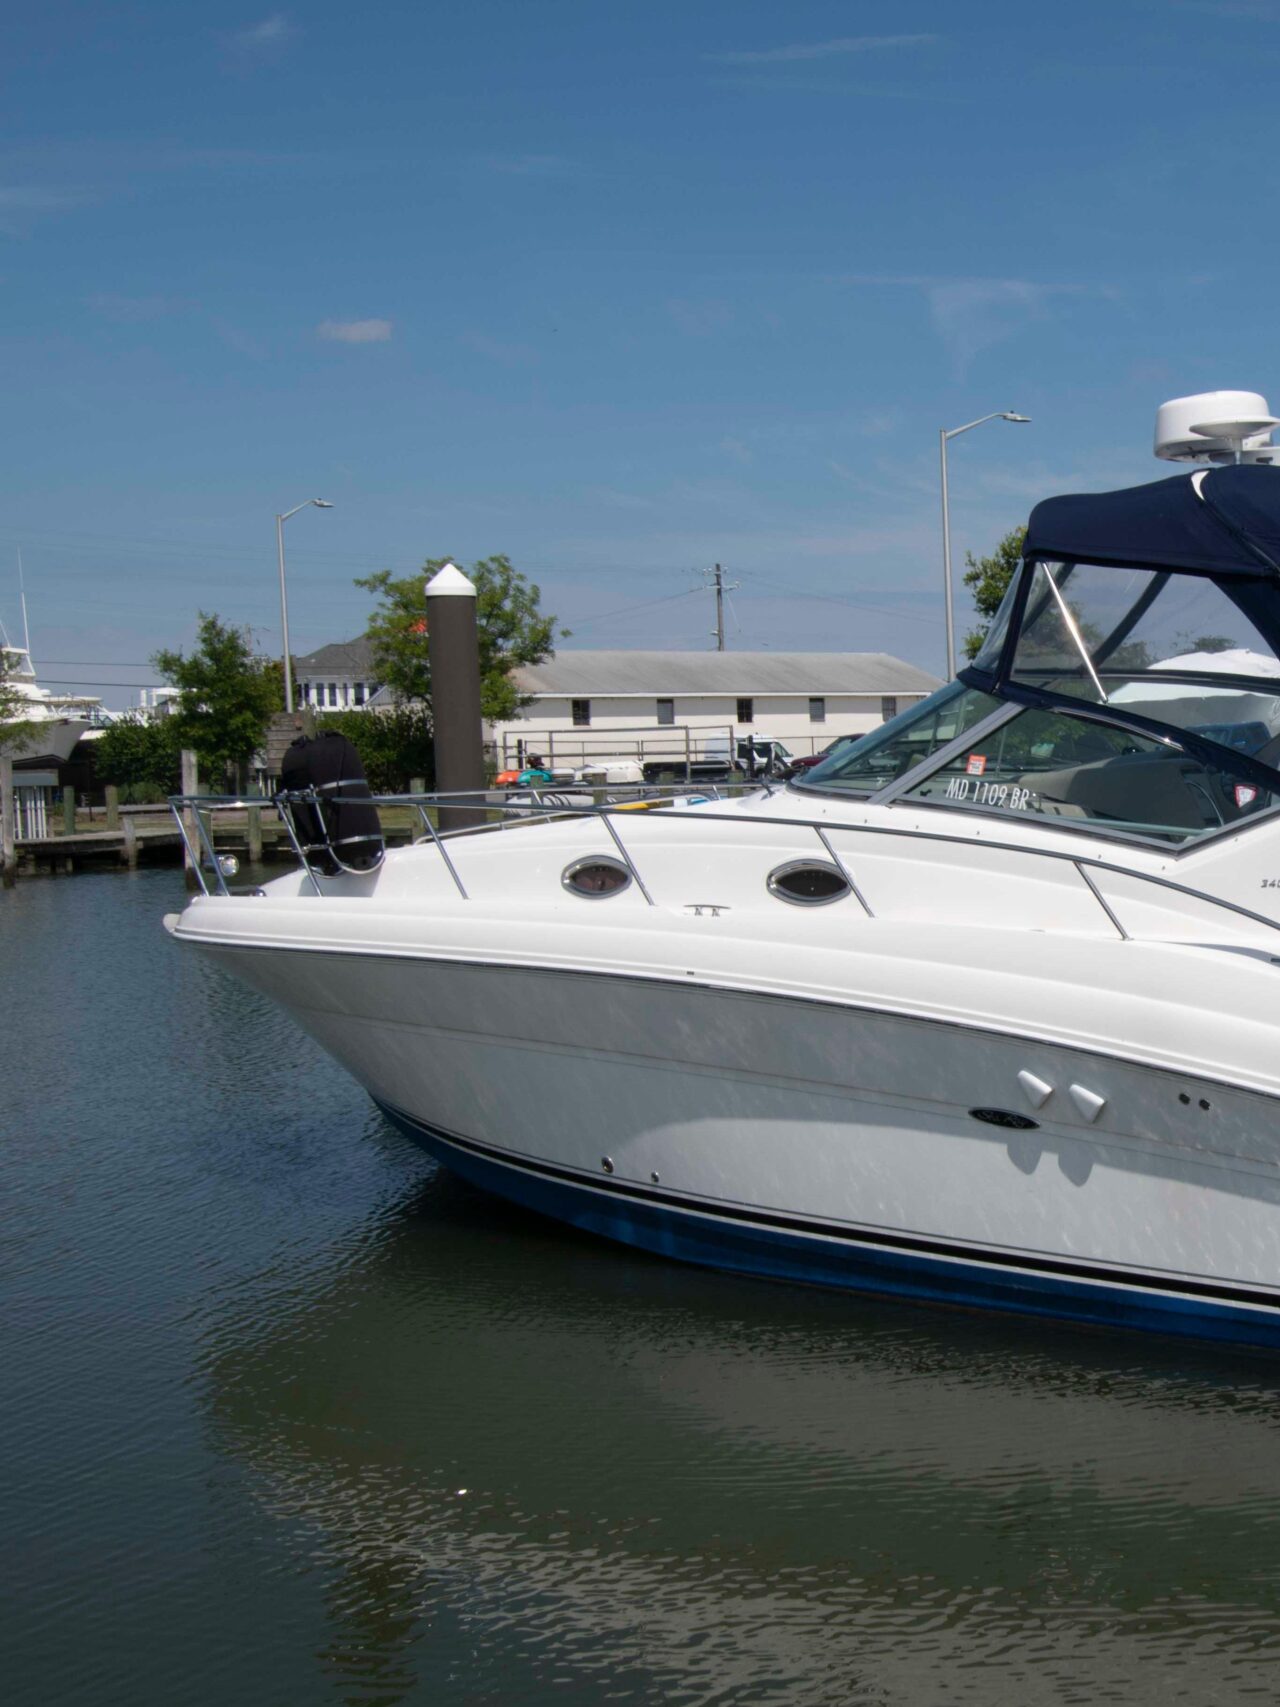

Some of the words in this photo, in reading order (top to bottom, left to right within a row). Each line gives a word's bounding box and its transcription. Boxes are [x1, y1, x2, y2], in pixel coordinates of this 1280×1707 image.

[946, 777, 969, 800] MD
[973, 781, 1008, 806] 1109
[1009, 787, 1030, 811] BR
